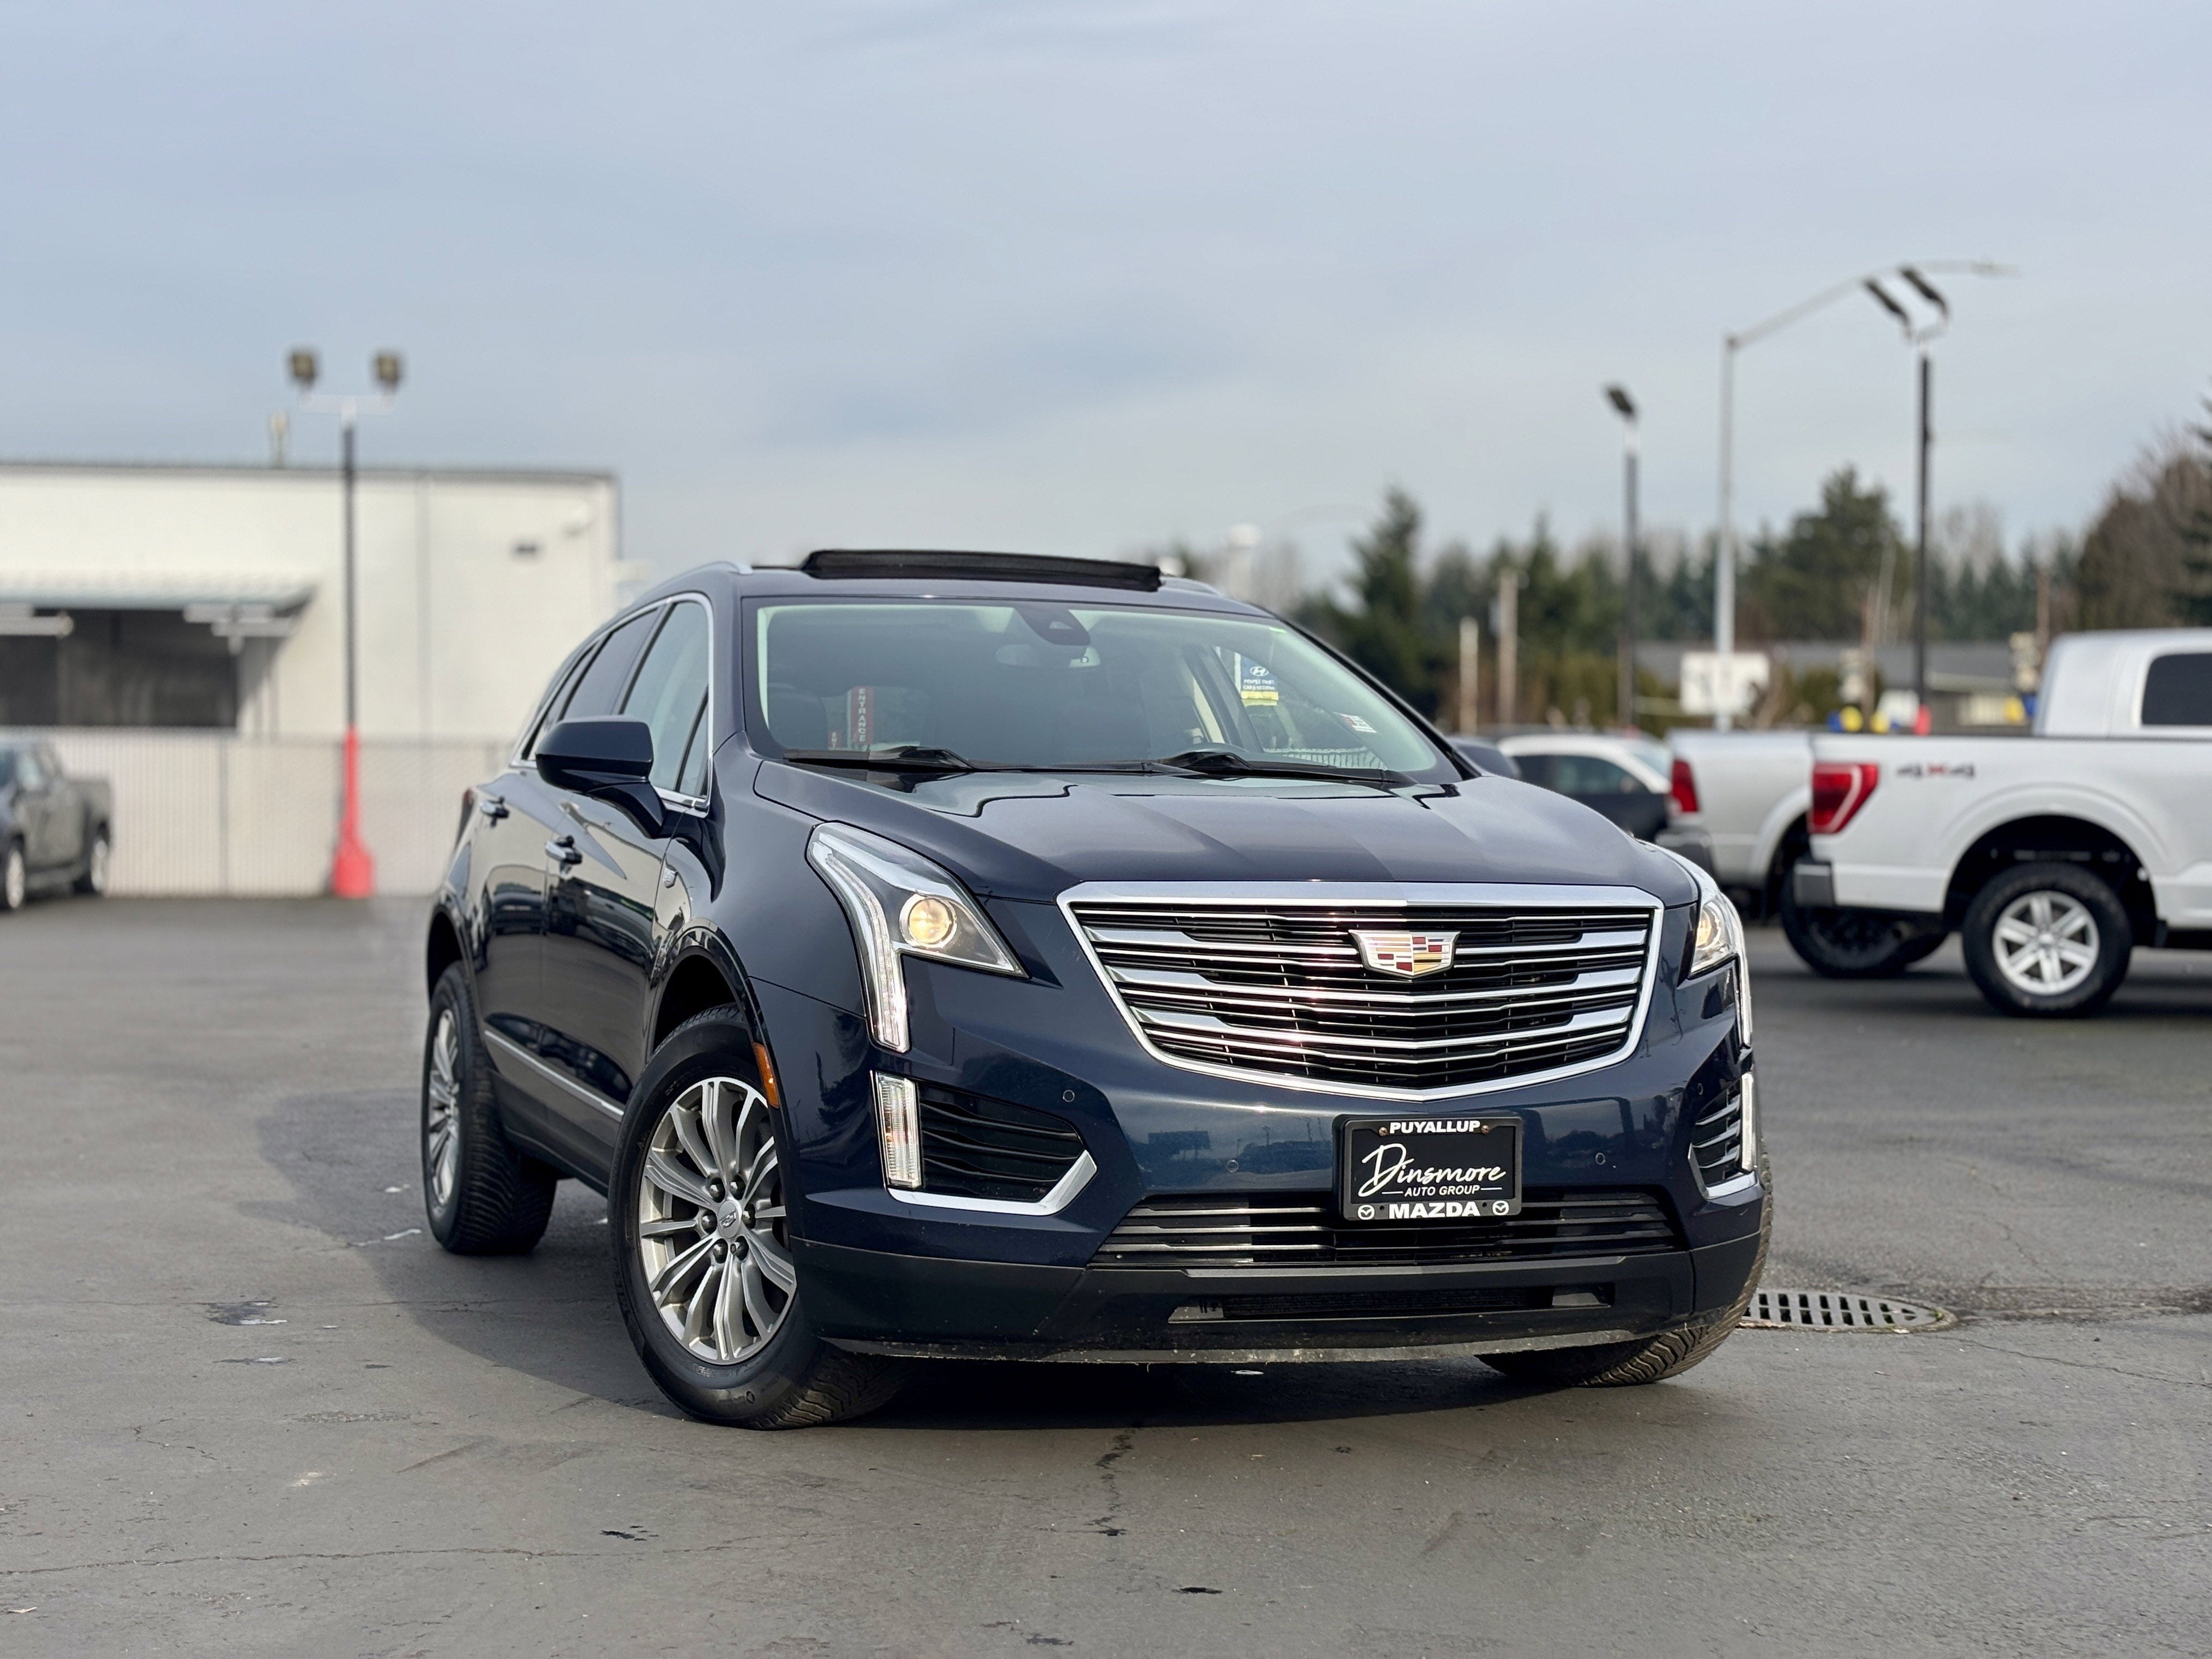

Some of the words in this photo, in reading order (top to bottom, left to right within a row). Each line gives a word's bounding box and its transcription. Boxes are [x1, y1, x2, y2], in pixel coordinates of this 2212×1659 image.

[858, 688, 866, 742] ENTRANCE
[1389, 1120, 1481, 1134] PUYALLUP
[1358, 1143, 1506, 1197] Dinsmore
[1404, 1187, 1436, 1197] AUTO
[1438, 1184, 1480, 1196] GROUP
[1389, 1201, 1481, 1219] MAZDA
